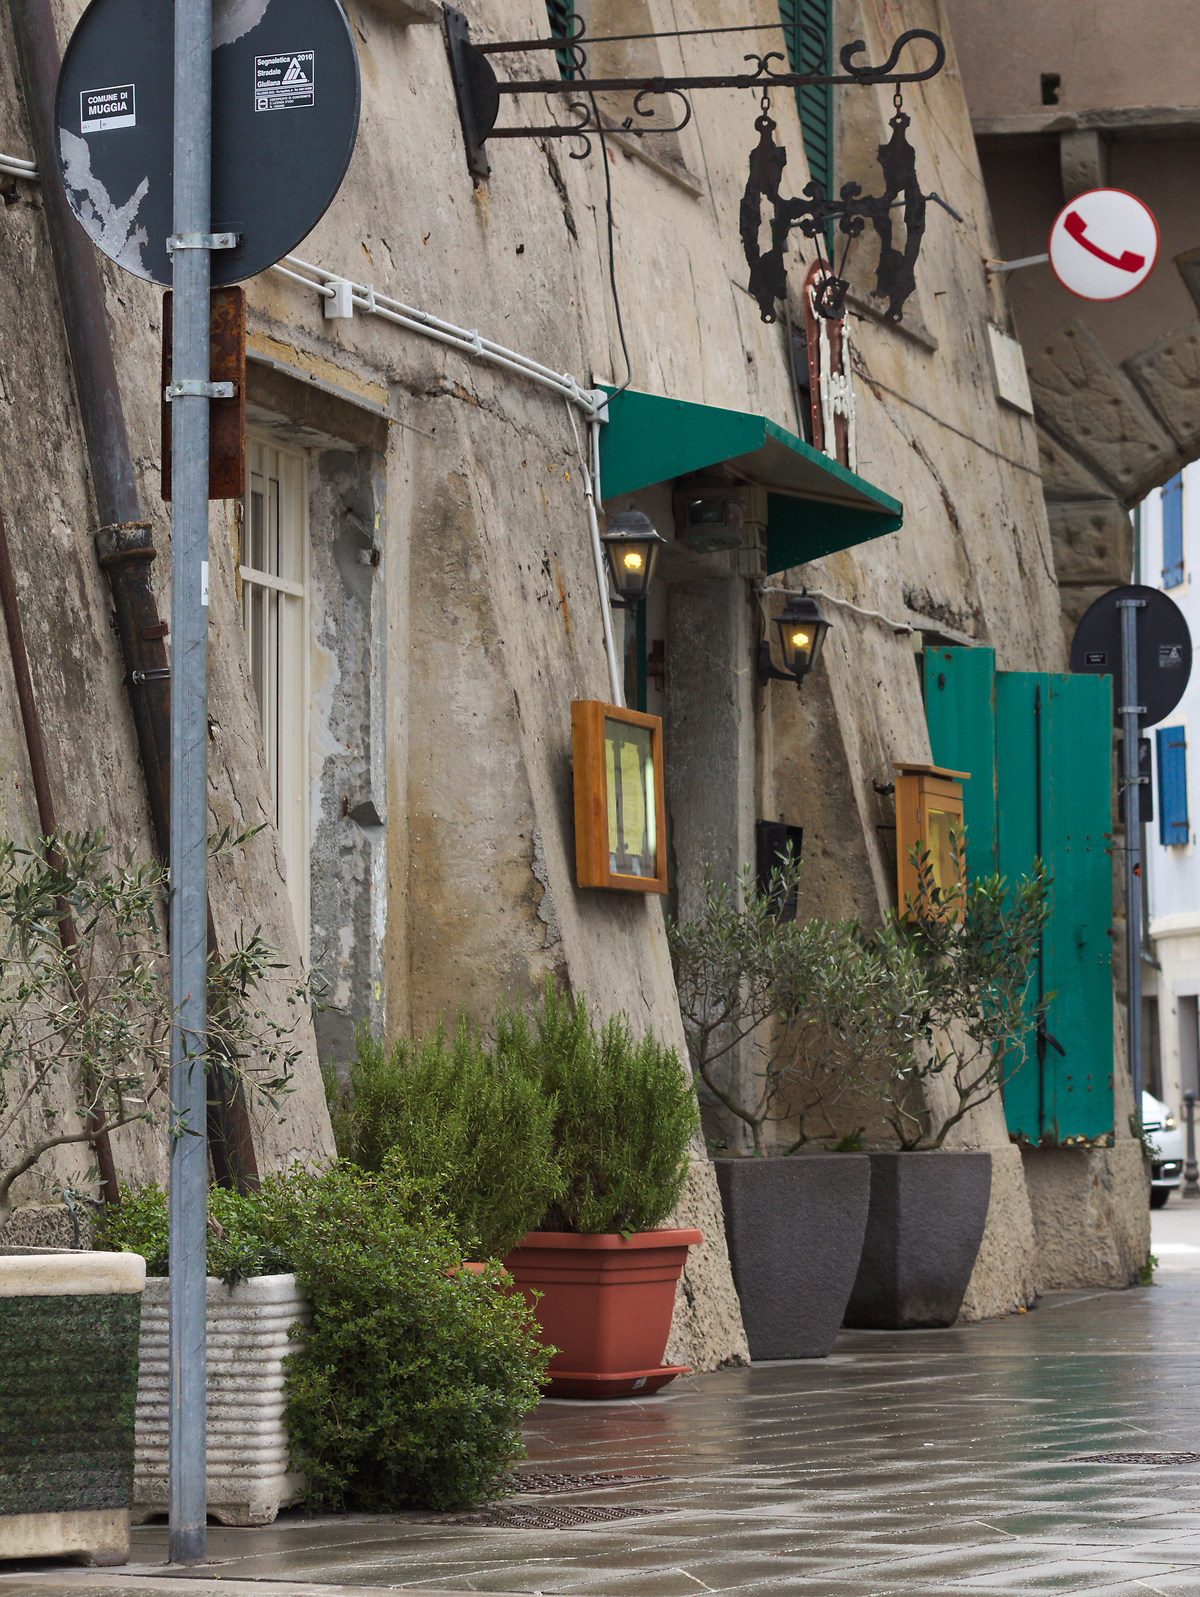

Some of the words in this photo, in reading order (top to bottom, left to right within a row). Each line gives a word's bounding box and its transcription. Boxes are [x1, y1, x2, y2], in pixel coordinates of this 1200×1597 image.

[257, 56, 290, 66] Segnaletica
[257, 68, 281, 77] Stradale
[257, 80, 281, 88] Giuliana
[88, 93, 118, 104] COMUNE
[88, 101, 128, 116] MUGGIA
